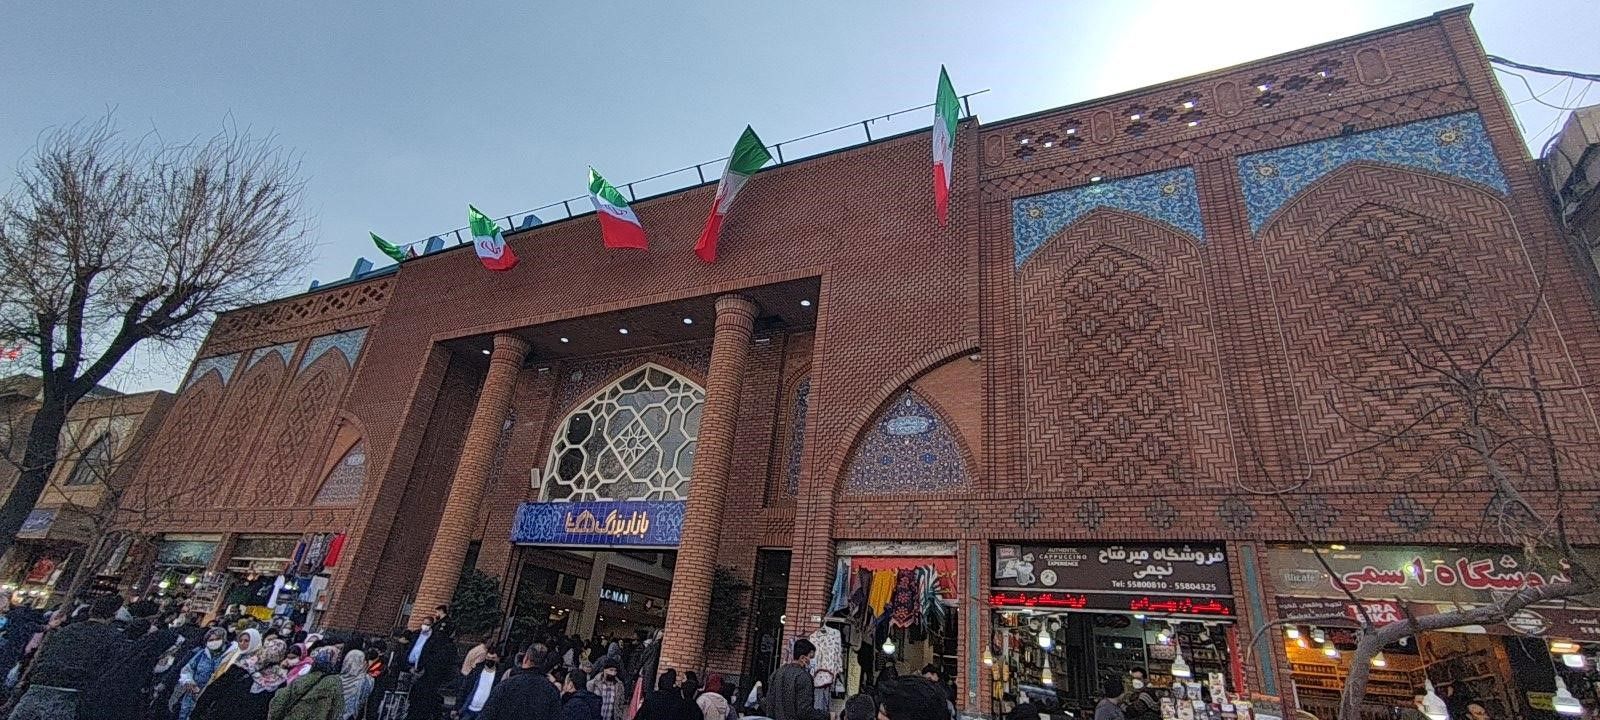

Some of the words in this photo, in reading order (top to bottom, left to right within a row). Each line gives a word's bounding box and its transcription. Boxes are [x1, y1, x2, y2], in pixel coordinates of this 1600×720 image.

[595, 509, 624, 538] بزرگ
[623, 511, 649, 538] بازار
[1153, 545, 1224, 564] فروشگاه
[1133, 562, 1173, 578] نجمی
[1112, 580, 1125, 588] Tel:
[1127, 581, 1167, 589] 55800810
[1175, 583, 1216, 591] 55804325
[612, 590, 629, 603] MAN
